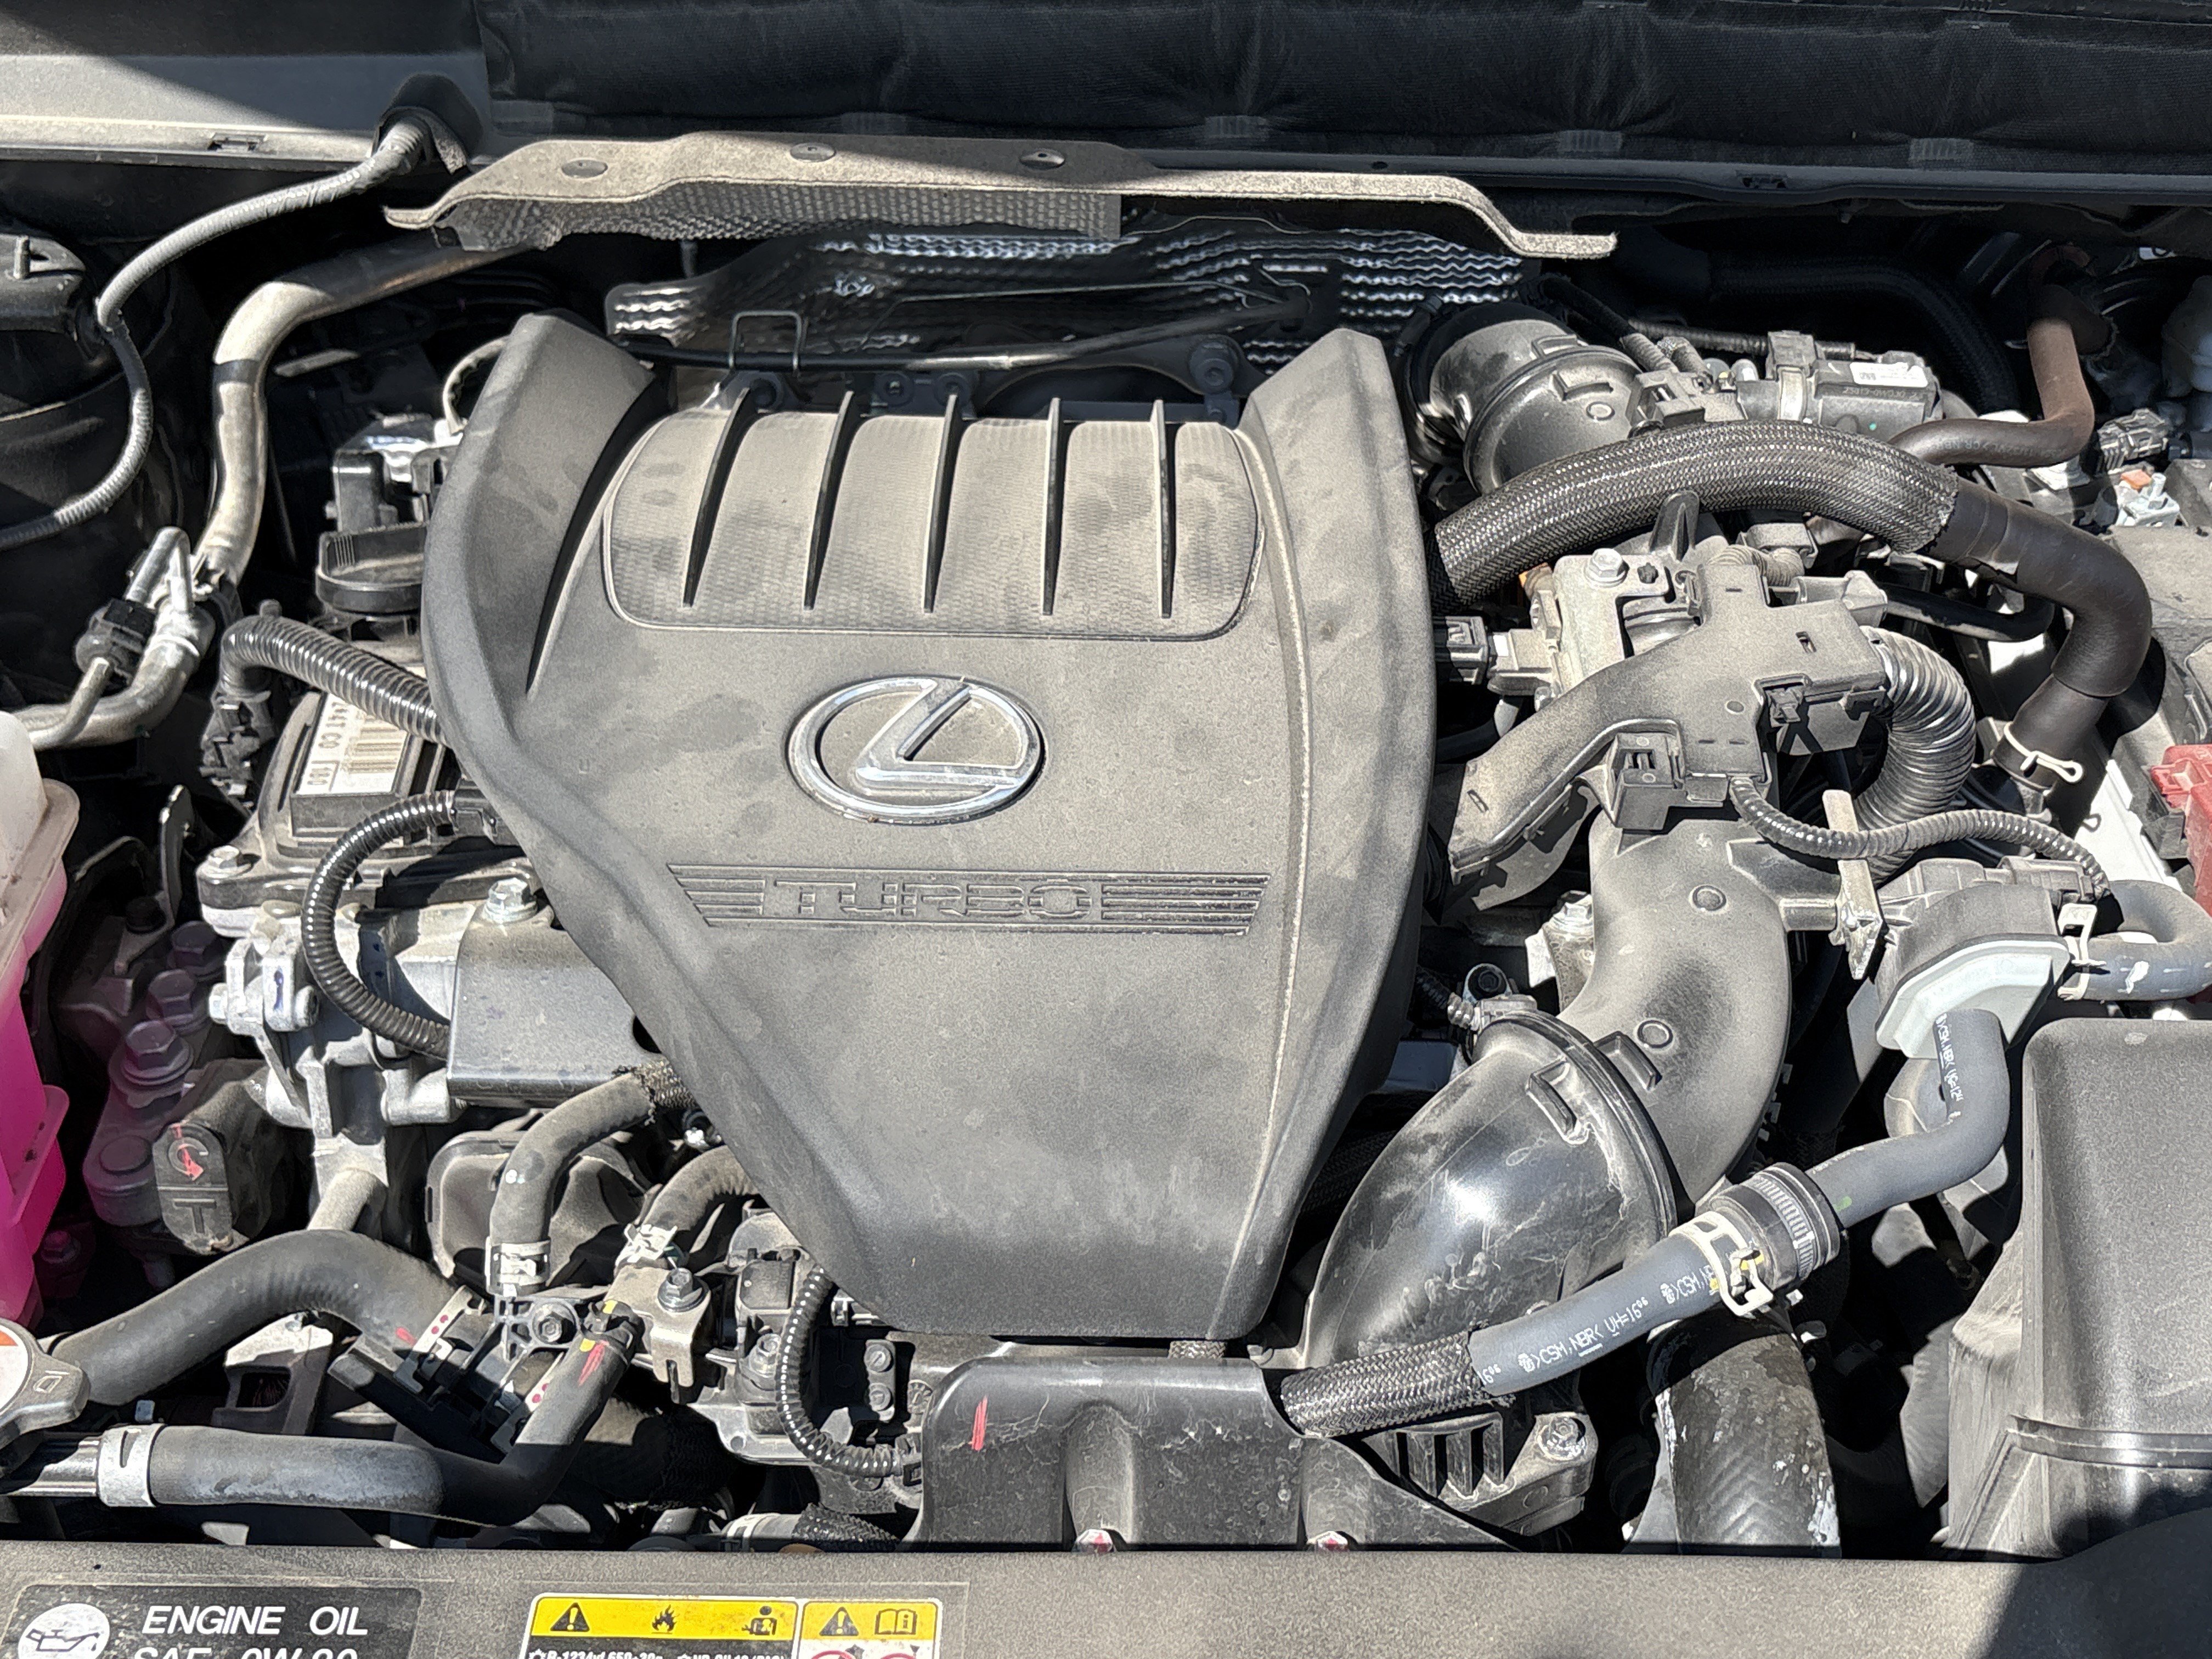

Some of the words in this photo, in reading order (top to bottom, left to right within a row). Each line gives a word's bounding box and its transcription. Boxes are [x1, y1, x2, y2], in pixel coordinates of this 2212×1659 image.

[775, 880, 1092, 920] TURBO
[142, 1605, 286, 1635] ENGINE
[309, 1606, 368, 1636] OIL
